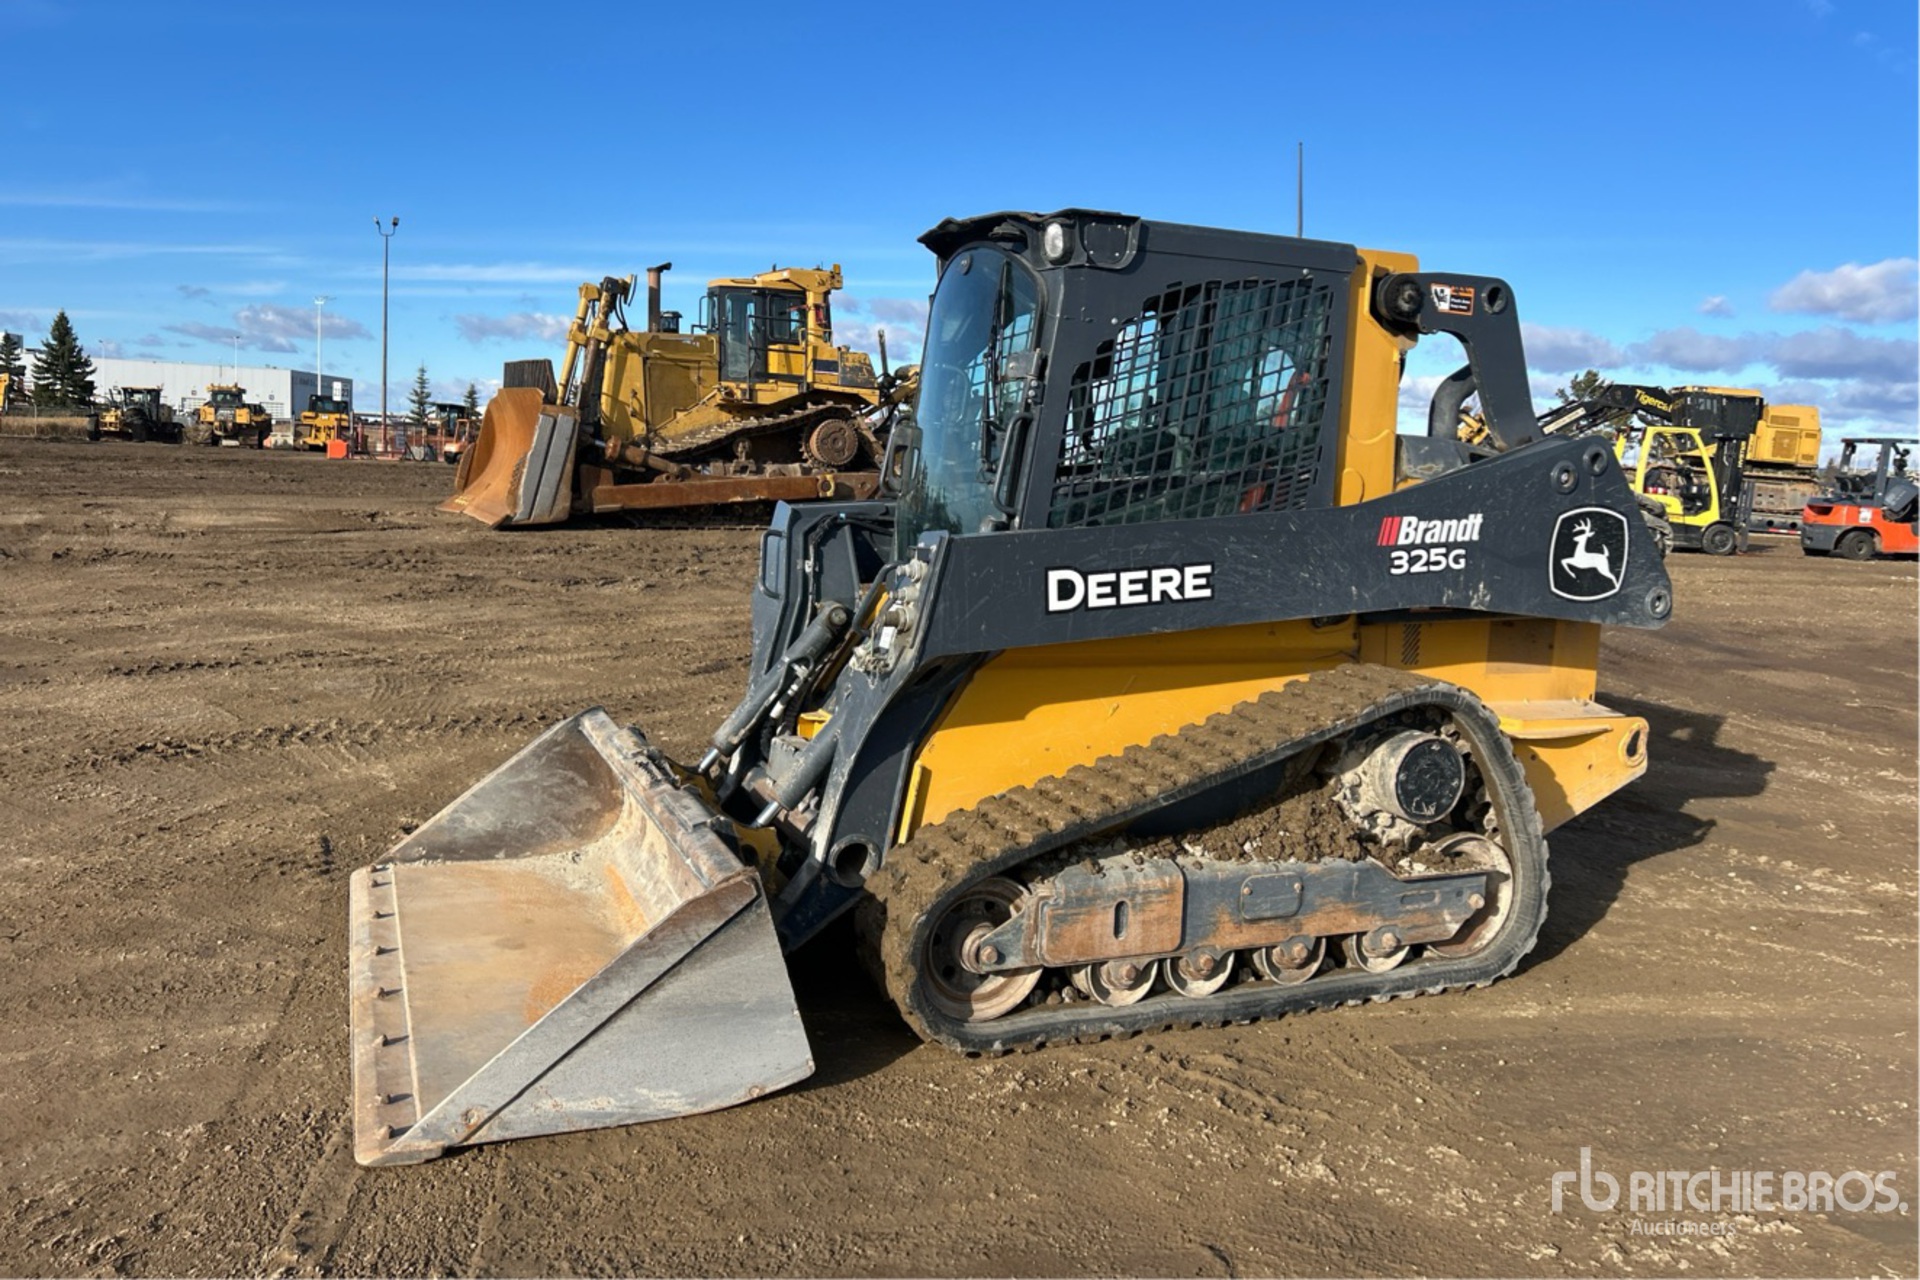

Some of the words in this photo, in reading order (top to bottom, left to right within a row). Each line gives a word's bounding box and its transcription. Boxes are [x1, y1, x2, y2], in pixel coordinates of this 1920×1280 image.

[1397, 513, 1484, 546] Brandt
[1390, 547, 1466, 575] 325G
[1047, 564, 1212, 612] DEERE
